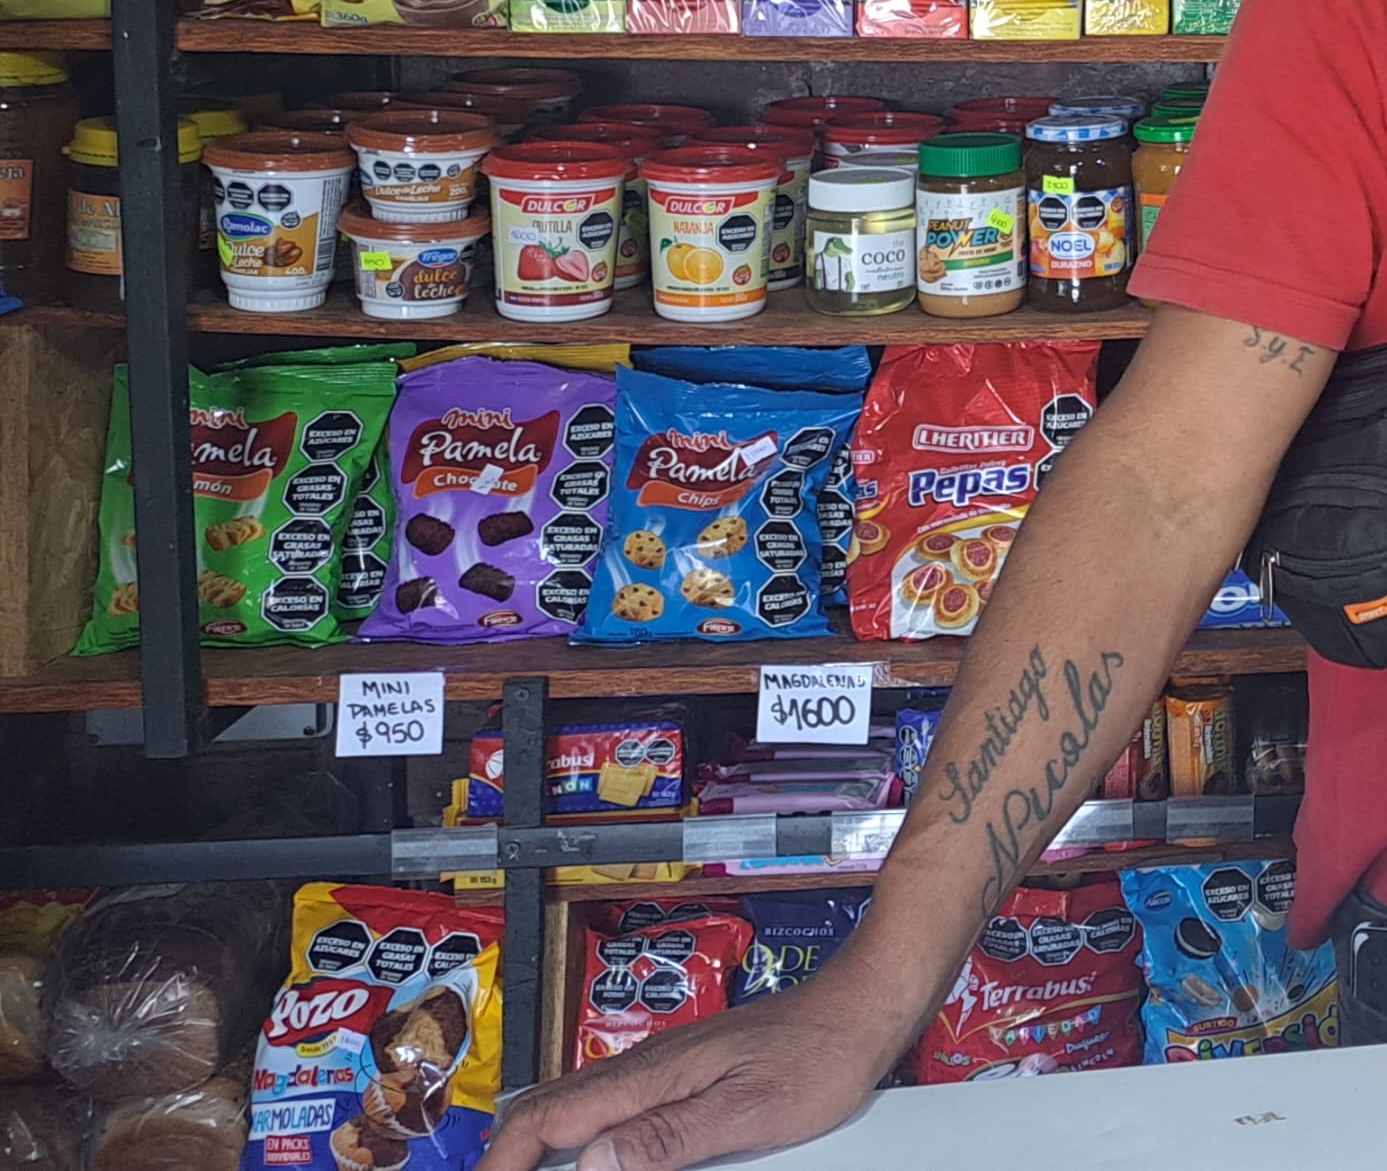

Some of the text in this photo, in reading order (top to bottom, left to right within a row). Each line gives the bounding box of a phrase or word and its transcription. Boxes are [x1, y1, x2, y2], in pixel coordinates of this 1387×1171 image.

[526, 196, 590, 215] DULCOR
[669, 198, 734, 215] DULCOR
[672, 220, 717, 236] NARANJA
[926, 218, 974, 232] PEANUT
[924, 229, 1000, 254] POWER
[1050, 235, 1093, 255] NOEL
[860, 250, 907, 267] COCO
[1050, 258, 1094, 270] DURAZNO
[412, 268, 459, 286] dulce
[441, 408, 513, 429] mini
[419, 429, 541, 464] Pamela
[667, 428, 729, 452] mini
[917, 428, 1029, 451] LHERITIER
[907, 462, 1029, 507] Pepas
[676, 489, 721, 509] Chips
[361, 680, 411, 697] MINI
[763, 672, 867, 691] MAGDALENAS
[346, 698, 437, 718] PAMELAS
[769, 695, 857, 731] $1600
[354, 722, 426, 749] $950
[267, 986, 370, 1037] POZO
[253, 1065, 356, 1092] Magdalenas
